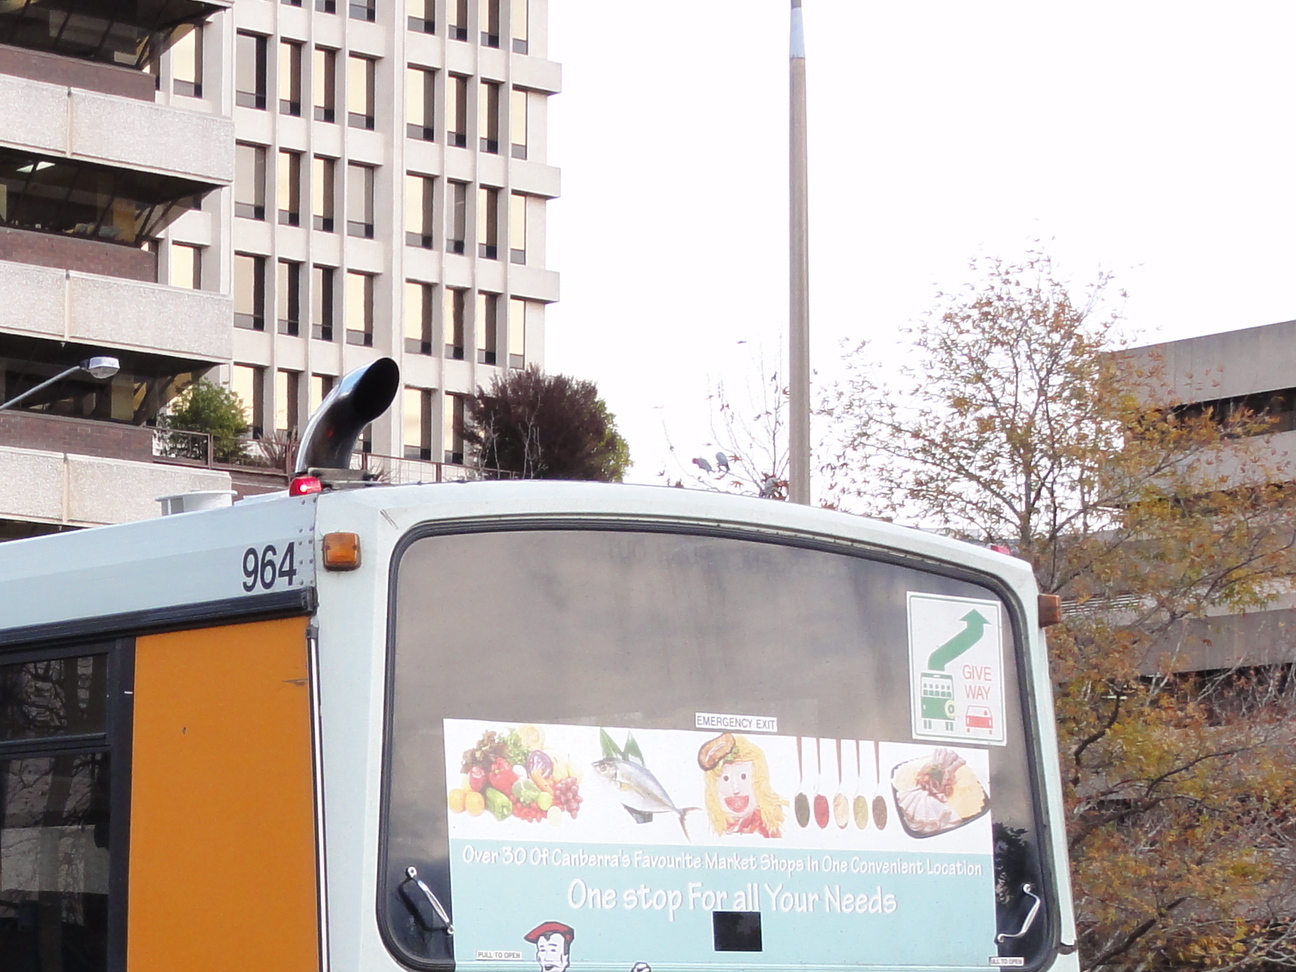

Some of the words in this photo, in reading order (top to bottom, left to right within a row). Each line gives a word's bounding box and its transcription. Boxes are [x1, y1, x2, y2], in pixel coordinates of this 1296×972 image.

[242, 541, 297, 593] 964
[962, 664, 992, 682] GIVE
[964, 684, 992, 701] WAY
[696, 715, 753, 728] EMERGENCY
[756, 719, 776, 730] EXIT
[462, 844, 499, 865] Over
[502, 846, 527, 866] 30
[553, 848, 632, 868] Canberra's
[634, 850, 702, 870] Favourite
[705, 852, 757, 871] Market
[760, 854, 805, 878] Shops
[807, 855, 821, 872] In
[822, 855, 849, 873] One
[851, 856, 925, 875] Convenient
[927, 858, 983, 876] Location
[567, 878, 618, 910] One
[623, 883, 683, 922] stop
[688, 881, 729, 911] For
[733, 882, 761, 912] all
[763, 883, 821, 913] Your
[824, 884, 898, 914] Needs
